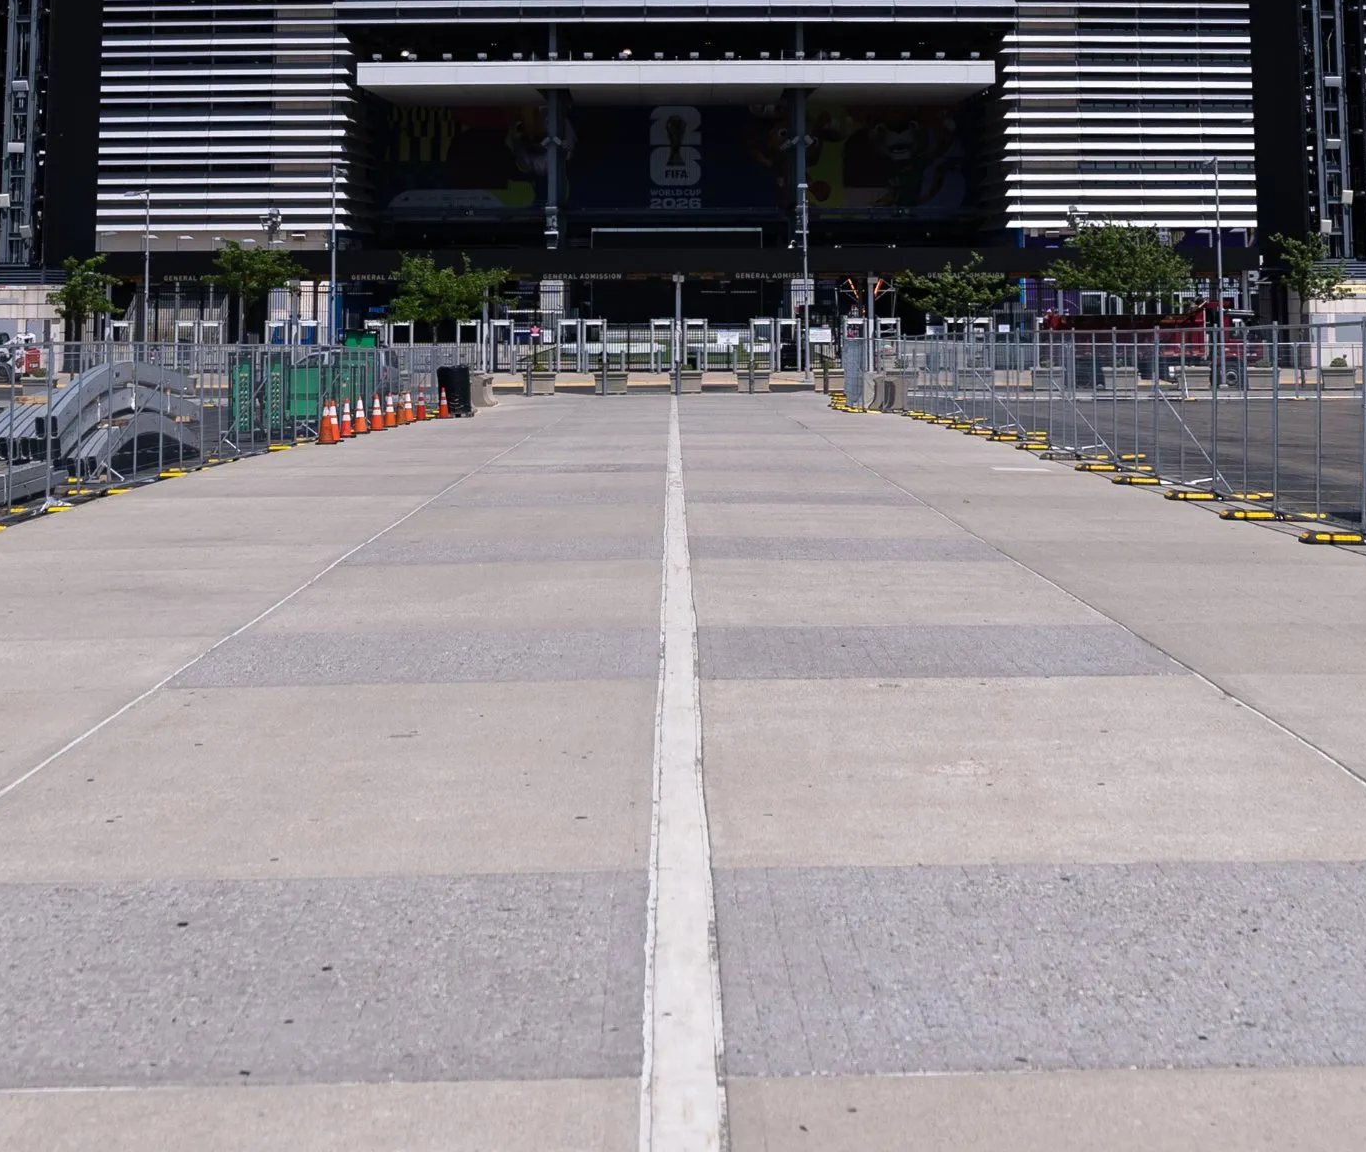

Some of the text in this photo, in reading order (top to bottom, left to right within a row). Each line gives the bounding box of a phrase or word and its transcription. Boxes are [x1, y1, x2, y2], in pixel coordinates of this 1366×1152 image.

[664, 169, 688, 179] FIFA
[650, 188, 702, 197] WORLD CUP
[649, 197, 702, 209] 2026
[163, 274, 197, 282] GENERAL
